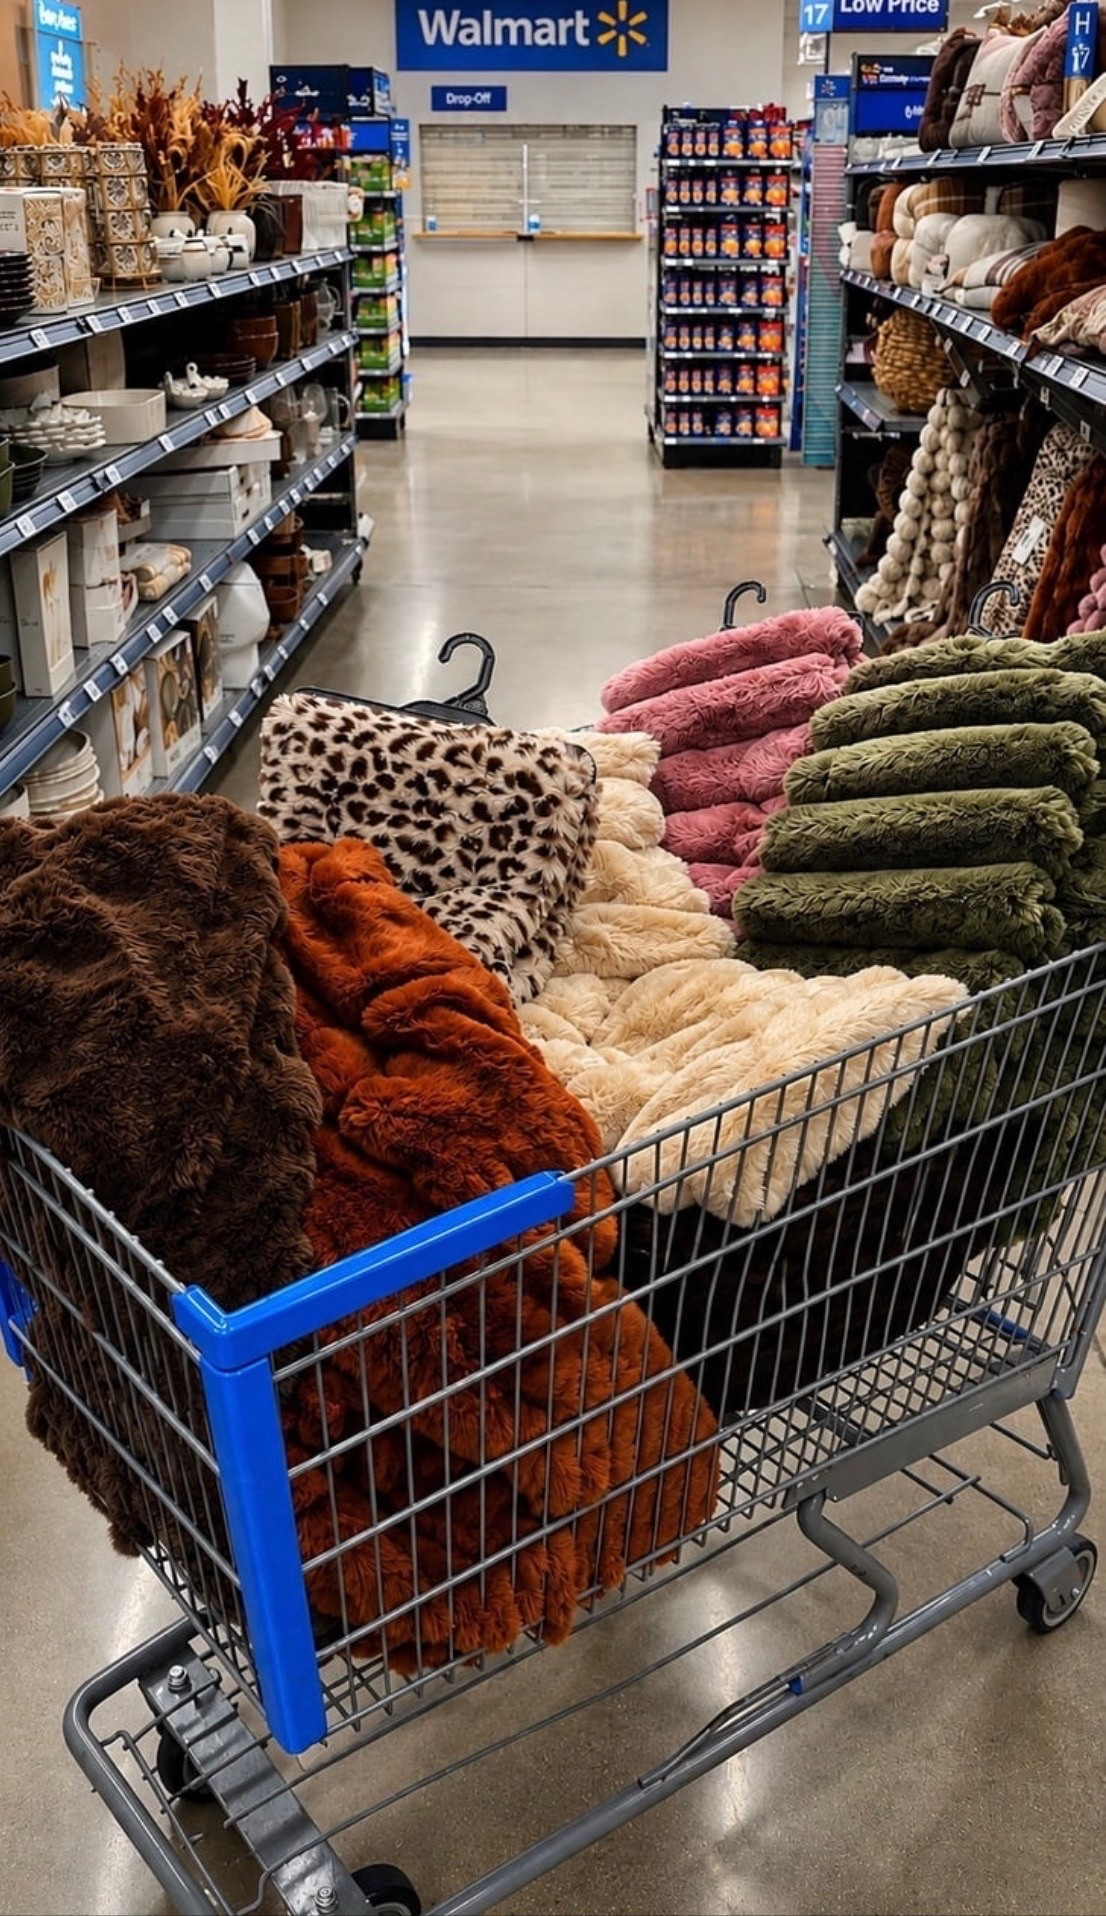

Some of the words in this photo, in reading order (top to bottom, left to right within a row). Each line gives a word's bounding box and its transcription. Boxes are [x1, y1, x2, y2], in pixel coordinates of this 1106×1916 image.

[804, 4, 829, 25] 17
[840, 0, 882, 13] Low
[888, 0, 940, 13] Price
[418, 9, 590, 46] Walmart
[1075, 11, 1090, 35] H
[446, 92, 491, 105] Drop-Off
